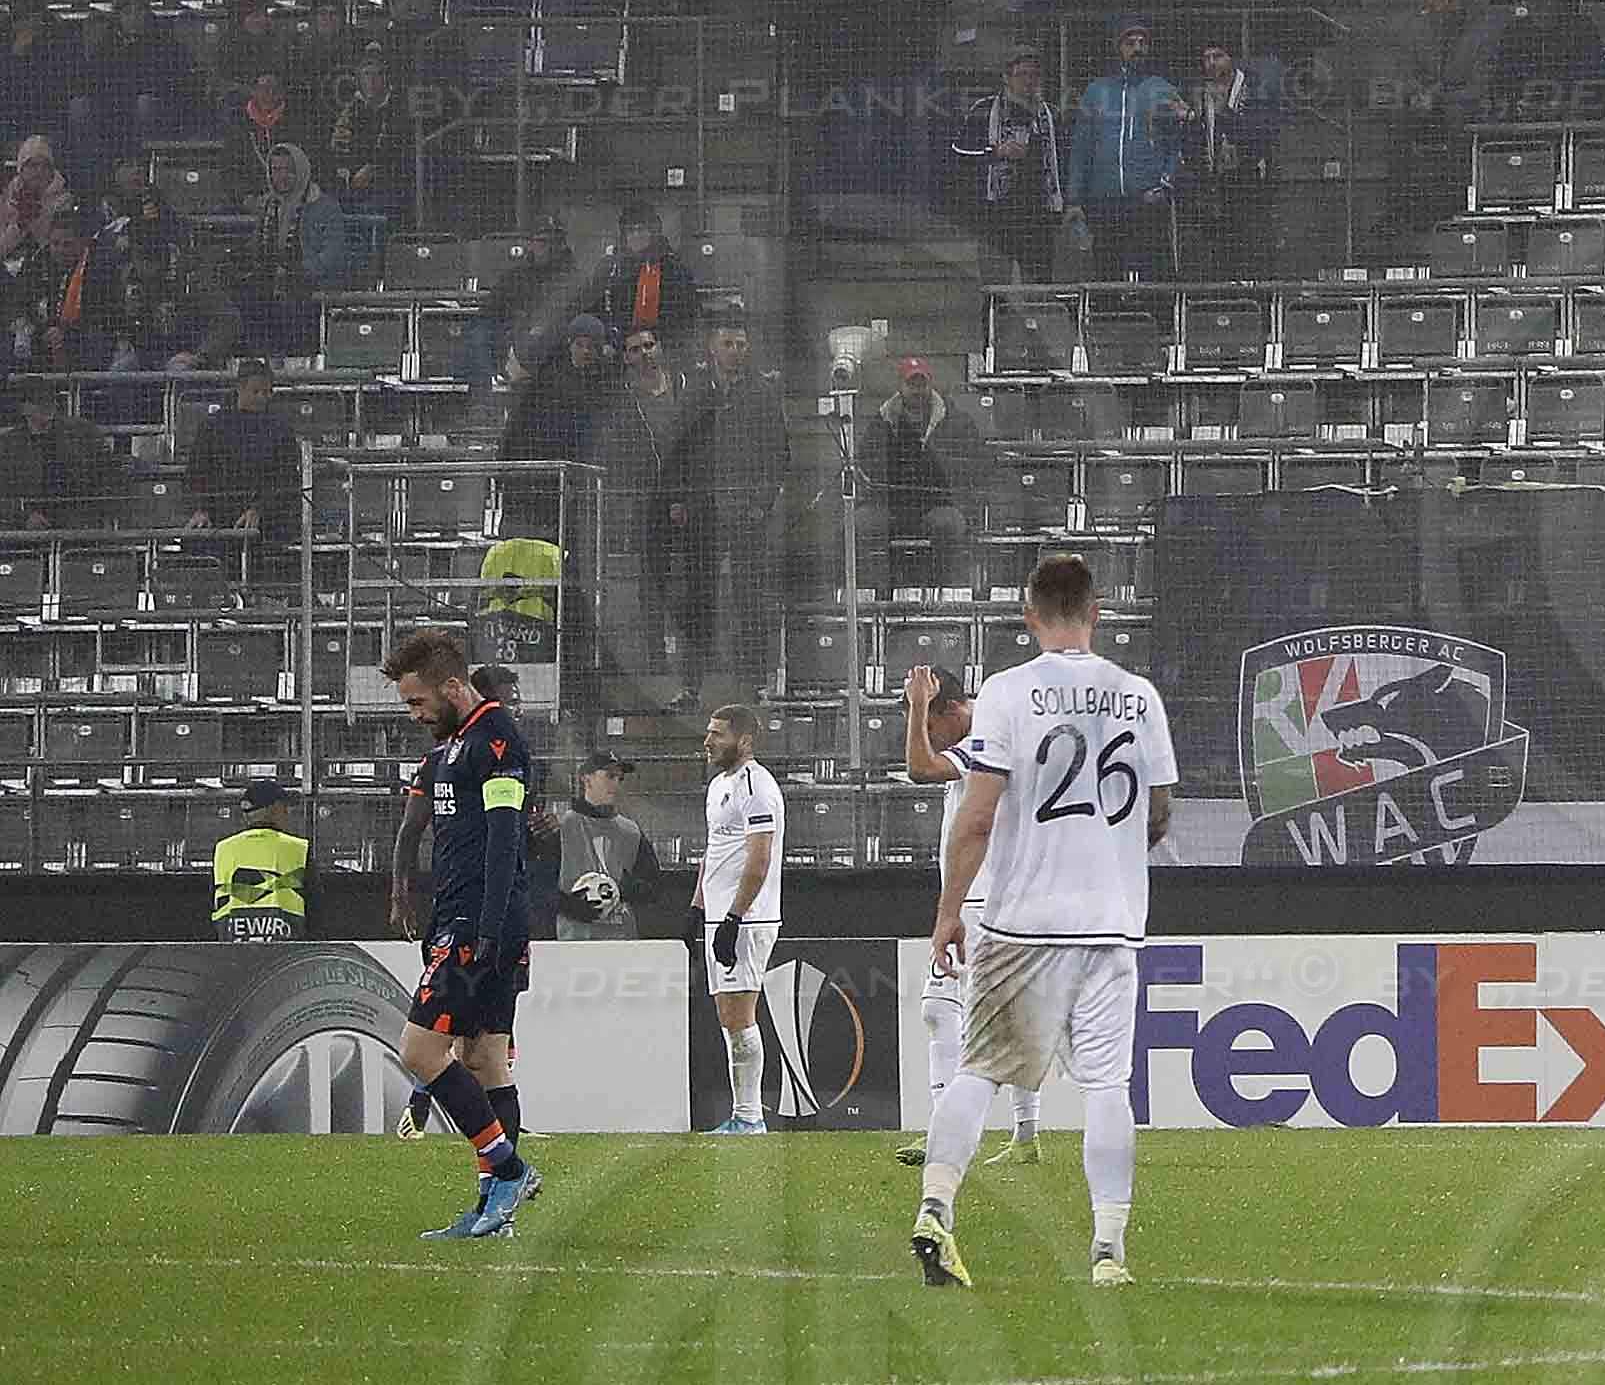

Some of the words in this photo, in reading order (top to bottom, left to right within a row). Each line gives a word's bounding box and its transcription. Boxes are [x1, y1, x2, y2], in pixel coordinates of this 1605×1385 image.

[1284, 633, 1431, 658] WOLFSBERGER
[1438, 645, 1464, 661] AC
[1031, 686, 1148, 723] SOLLBAUER
[1035, 723, 1138, 827] 26
[1285, 769, 1477, 866] WAC
